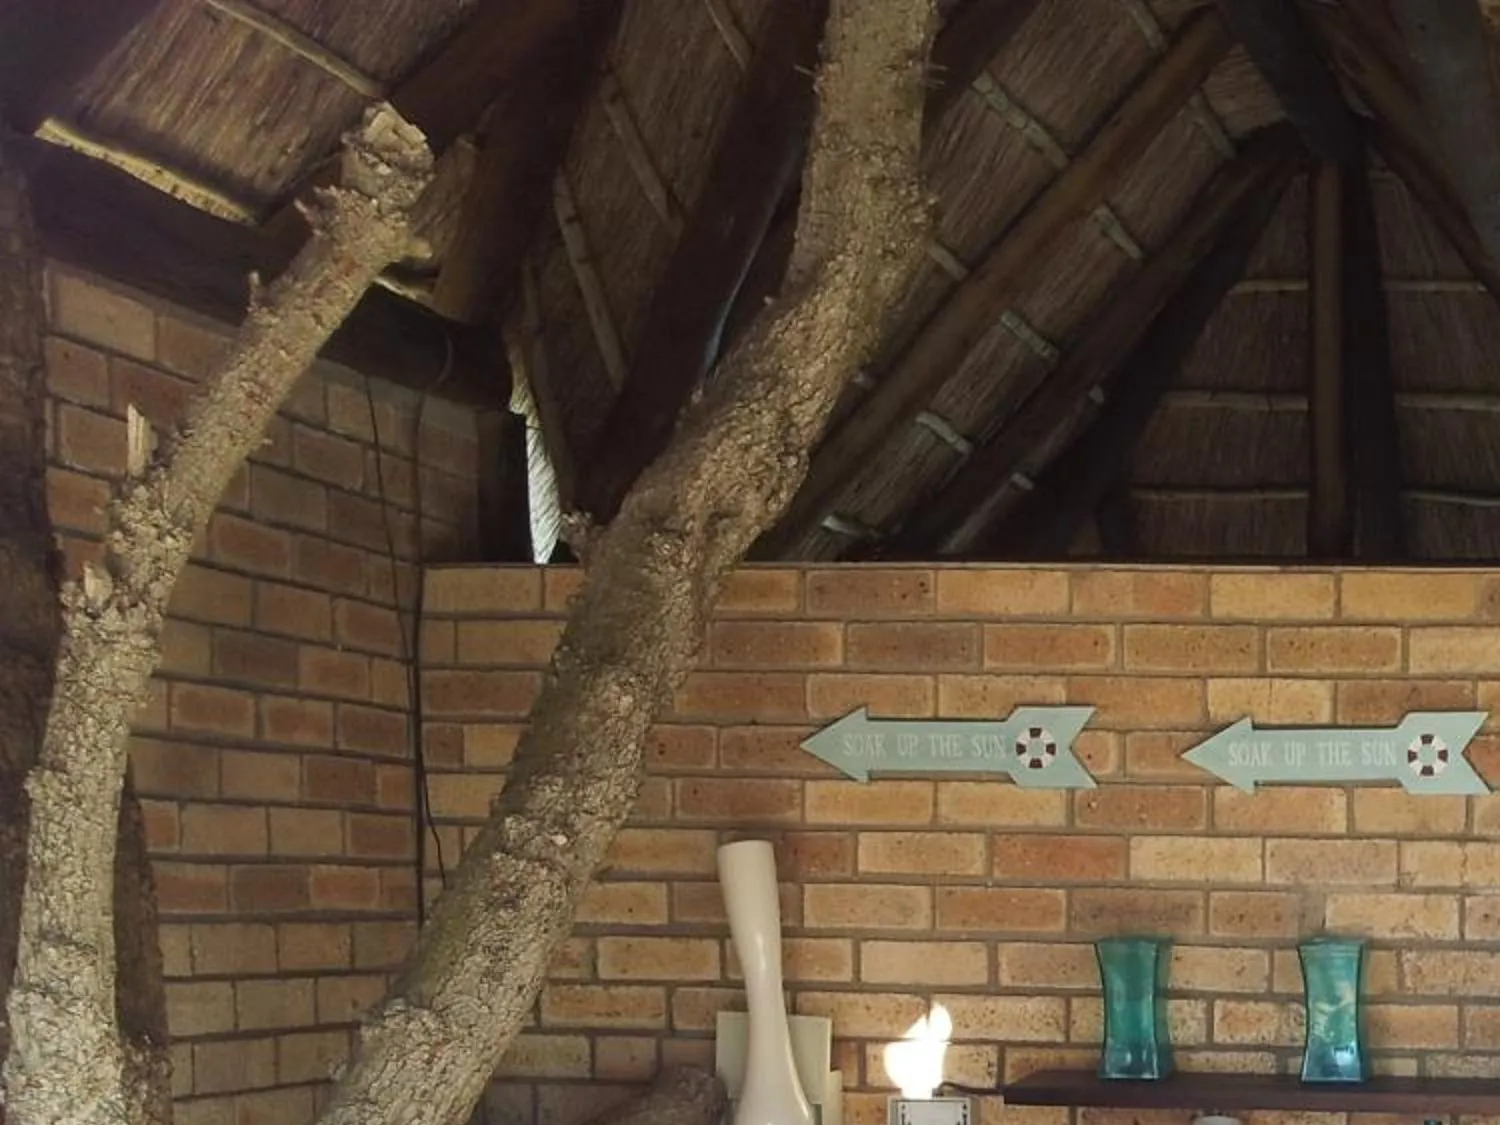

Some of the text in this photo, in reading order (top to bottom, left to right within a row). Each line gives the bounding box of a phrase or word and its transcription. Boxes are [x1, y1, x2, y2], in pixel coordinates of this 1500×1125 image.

[843, 733, 1007, 759] SOAK UP THE SUN
[1228, 741, 1397, 766] SOAK UP THE SUN
